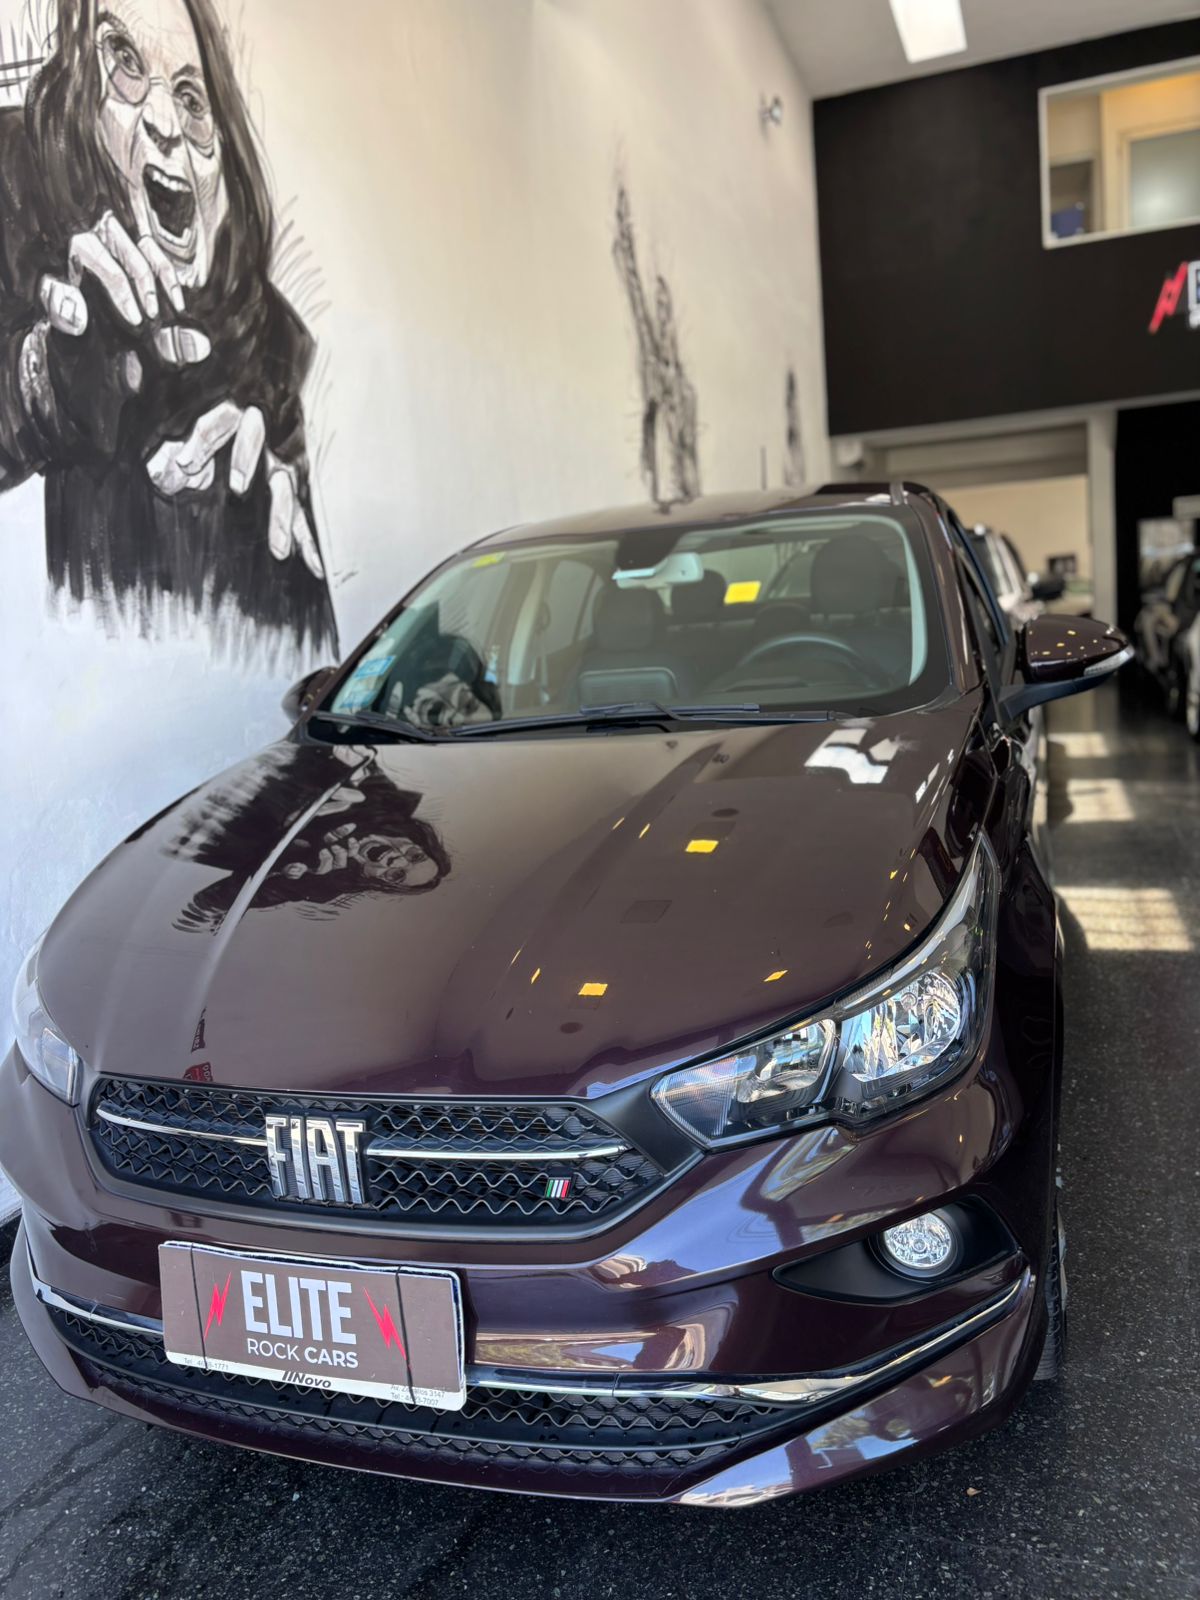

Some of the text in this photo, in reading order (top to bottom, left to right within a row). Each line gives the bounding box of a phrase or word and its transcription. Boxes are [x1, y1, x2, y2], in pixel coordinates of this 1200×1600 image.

[265, 1114, 366, 1204] FIAT
[240, 1270, 357, 1345] ELITE
[246, 1337, 359, 1369] ROCK CARS
